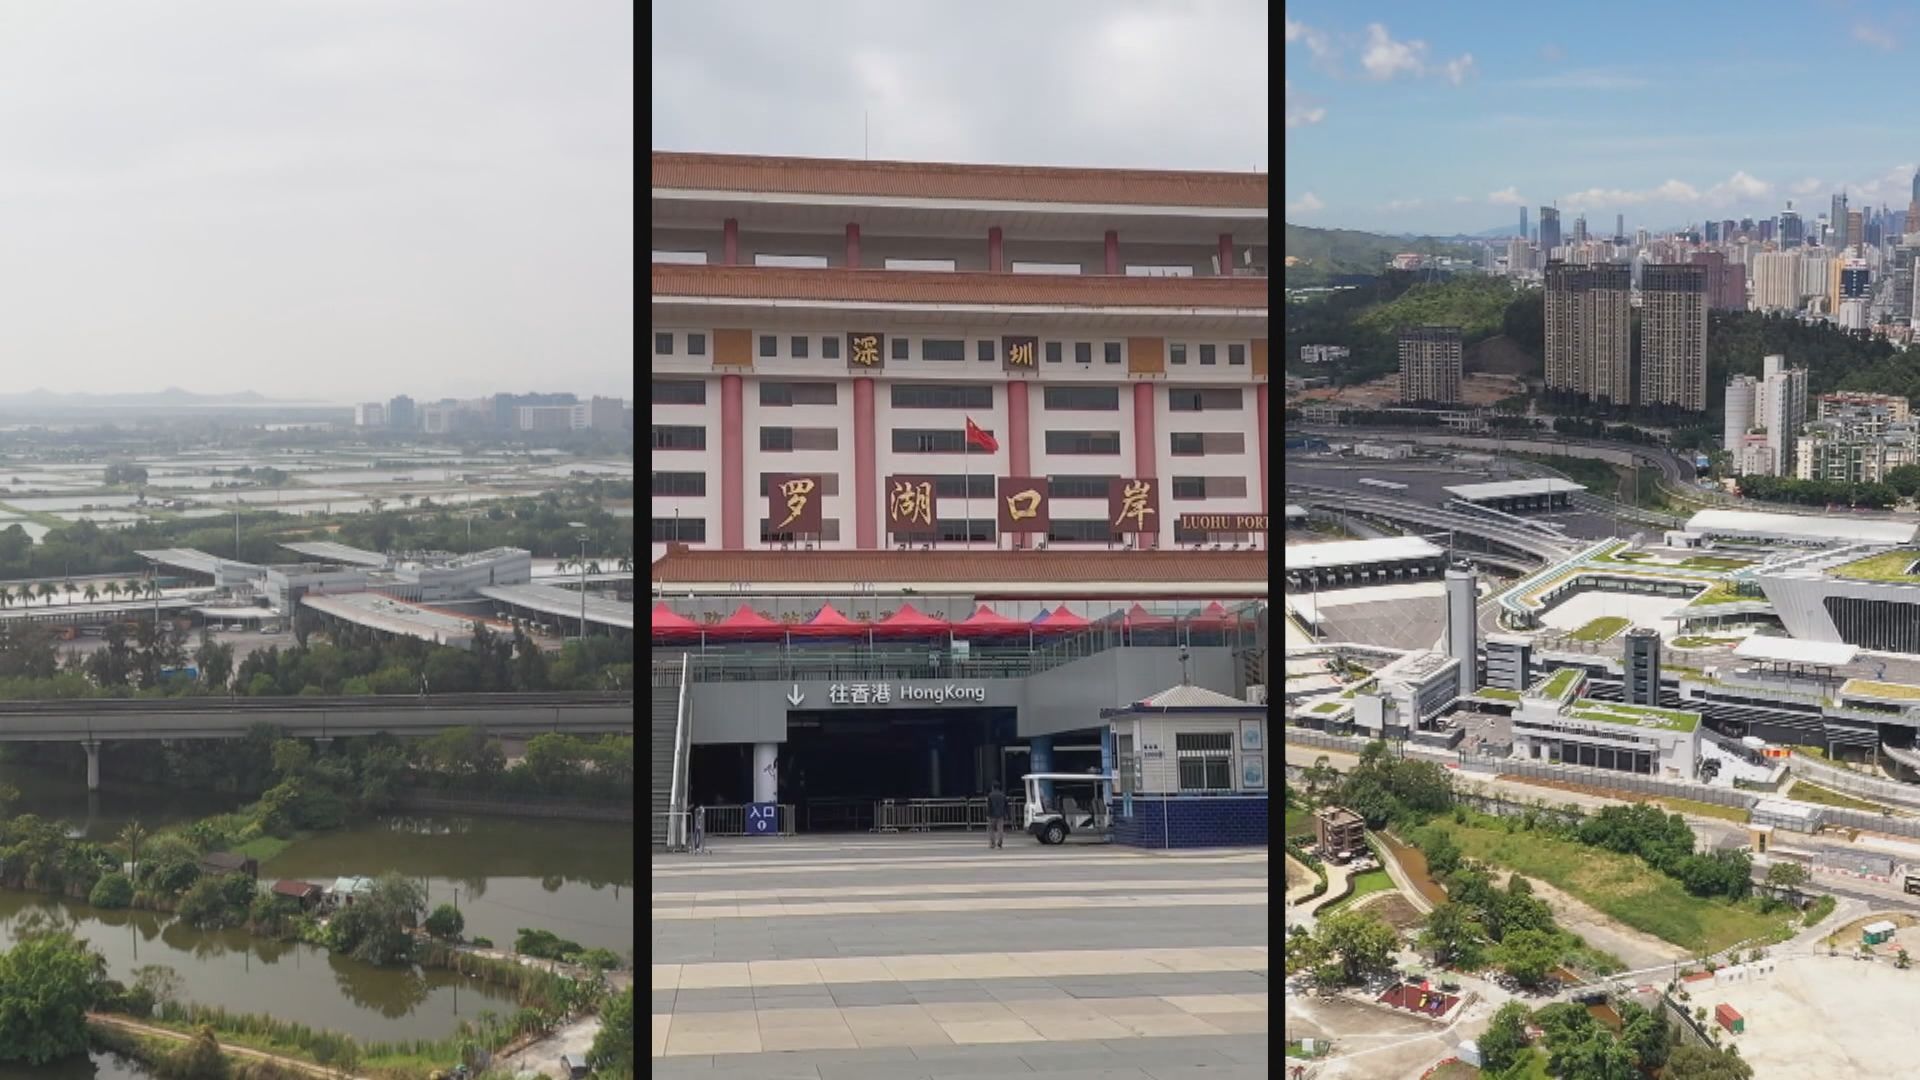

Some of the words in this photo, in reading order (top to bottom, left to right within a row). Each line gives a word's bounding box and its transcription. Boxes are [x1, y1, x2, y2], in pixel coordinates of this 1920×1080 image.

[854, 336, 1033, 366] 深圳
[777, 478, 1154, 529] 罗湖口岸
[1183, 515, 1230, 529] LUOHU
[829, 683, 891, 704] 往香港
[900, 684, 985, 704] HongKong
[750, 805, 775, 819] 入口
